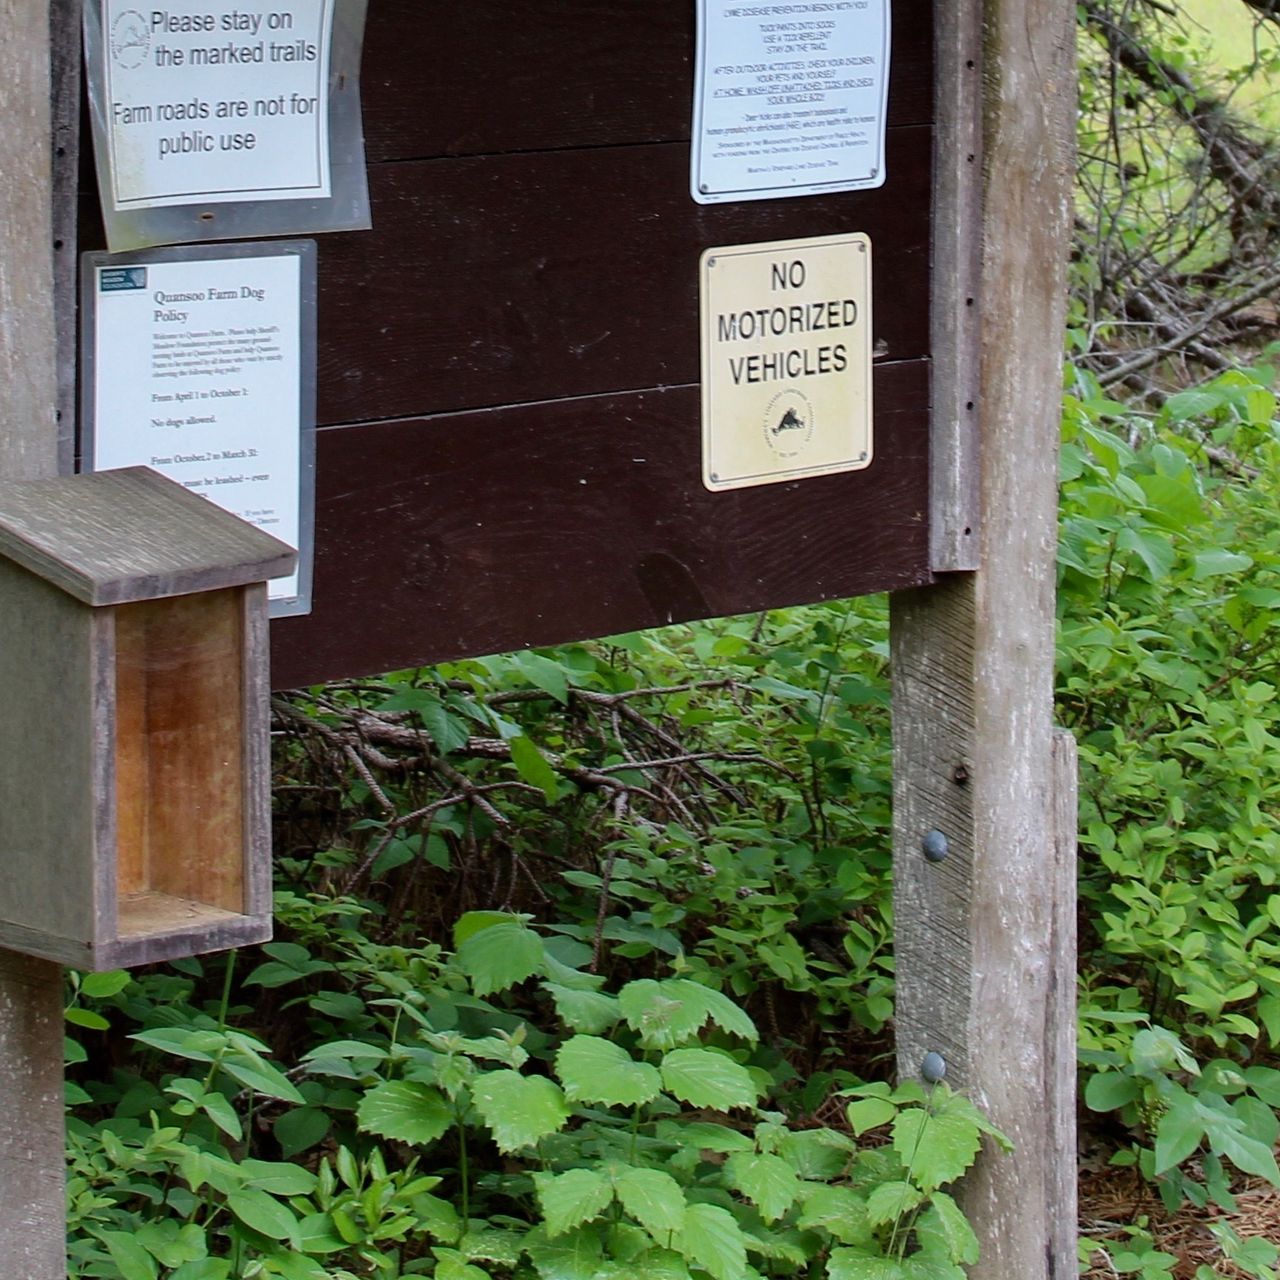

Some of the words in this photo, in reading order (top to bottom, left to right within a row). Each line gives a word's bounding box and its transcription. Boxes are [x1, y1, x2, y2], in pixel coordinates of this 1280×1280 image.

[150, 10, 216, 34] Please
[220, 10, 263, 36] stay
[270, 11, 293, 29] on
[154, 45, 185, 67] the
[189, 41, 264, 65] marked
[270, 39, 317, 63] trails
[113, 102, 153, 125] Farm
[156, 98, 210, 121] roads
[215, 99, 249, 118] are
[254, 94, 285, 116] not
[290, 93, 318, 115] for
[158, 130, 215, 160] public
[219, 131, 257, 151] use
[770, 259, 807, 291] NO
[153, 290, 205, 305] Quansoo
[208, 288, 238, 301] Farm
[240, 286, 265, 302] Dog
[153, 309, 188, 324] Policy
[717, 298, 859, 342] MOTORIZED
[728, 343, 848, 386] VEHICLES
[151, 393, 173, 403] From
[175, 391, 195, 403] April
[210, 388, 241, 398] October
[151, 419, 165, 427] No
[166, 418, 185, 428] dogs
[151, 456, 173, 465] From
[221, 450, 247, 459] March
